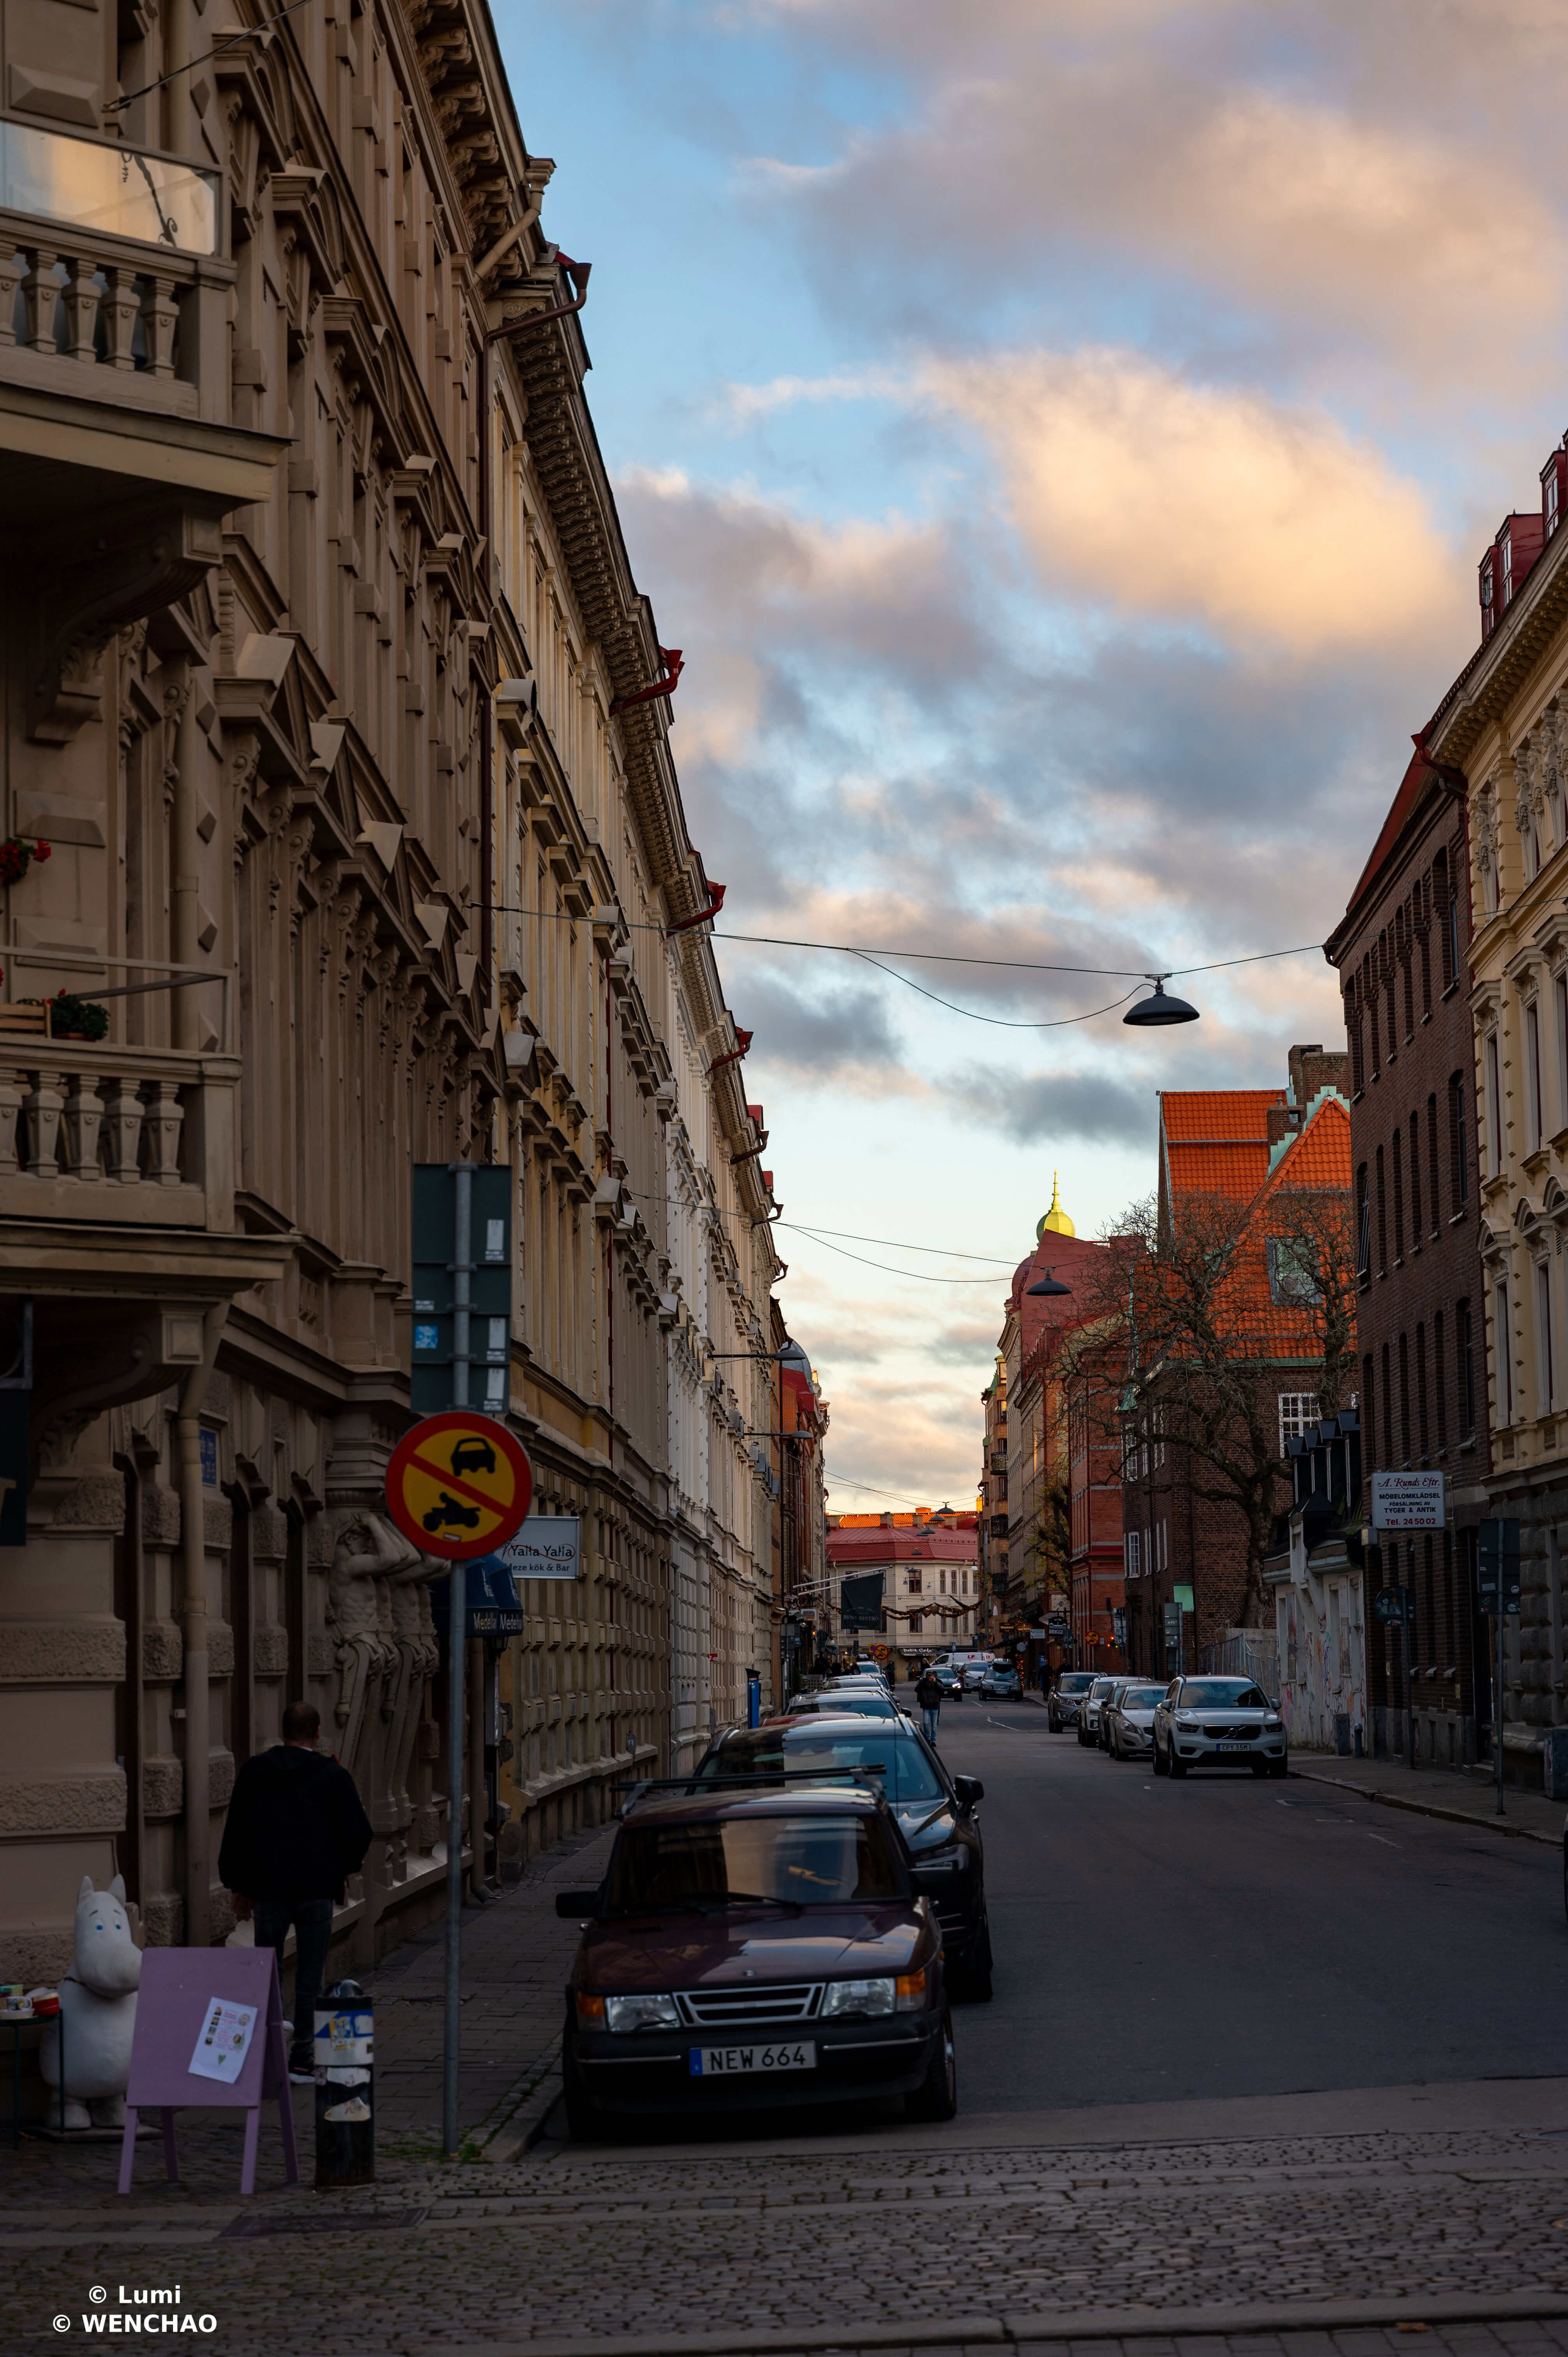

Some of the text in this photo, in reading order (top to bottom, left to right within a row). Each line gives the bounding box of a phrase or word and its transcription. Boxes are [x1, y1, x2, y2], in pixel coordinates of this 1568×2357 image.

[1378, 1477, 1440, 1489] A. Runds Eftr.
[710, 2046, 805, 2071] NEW 664
